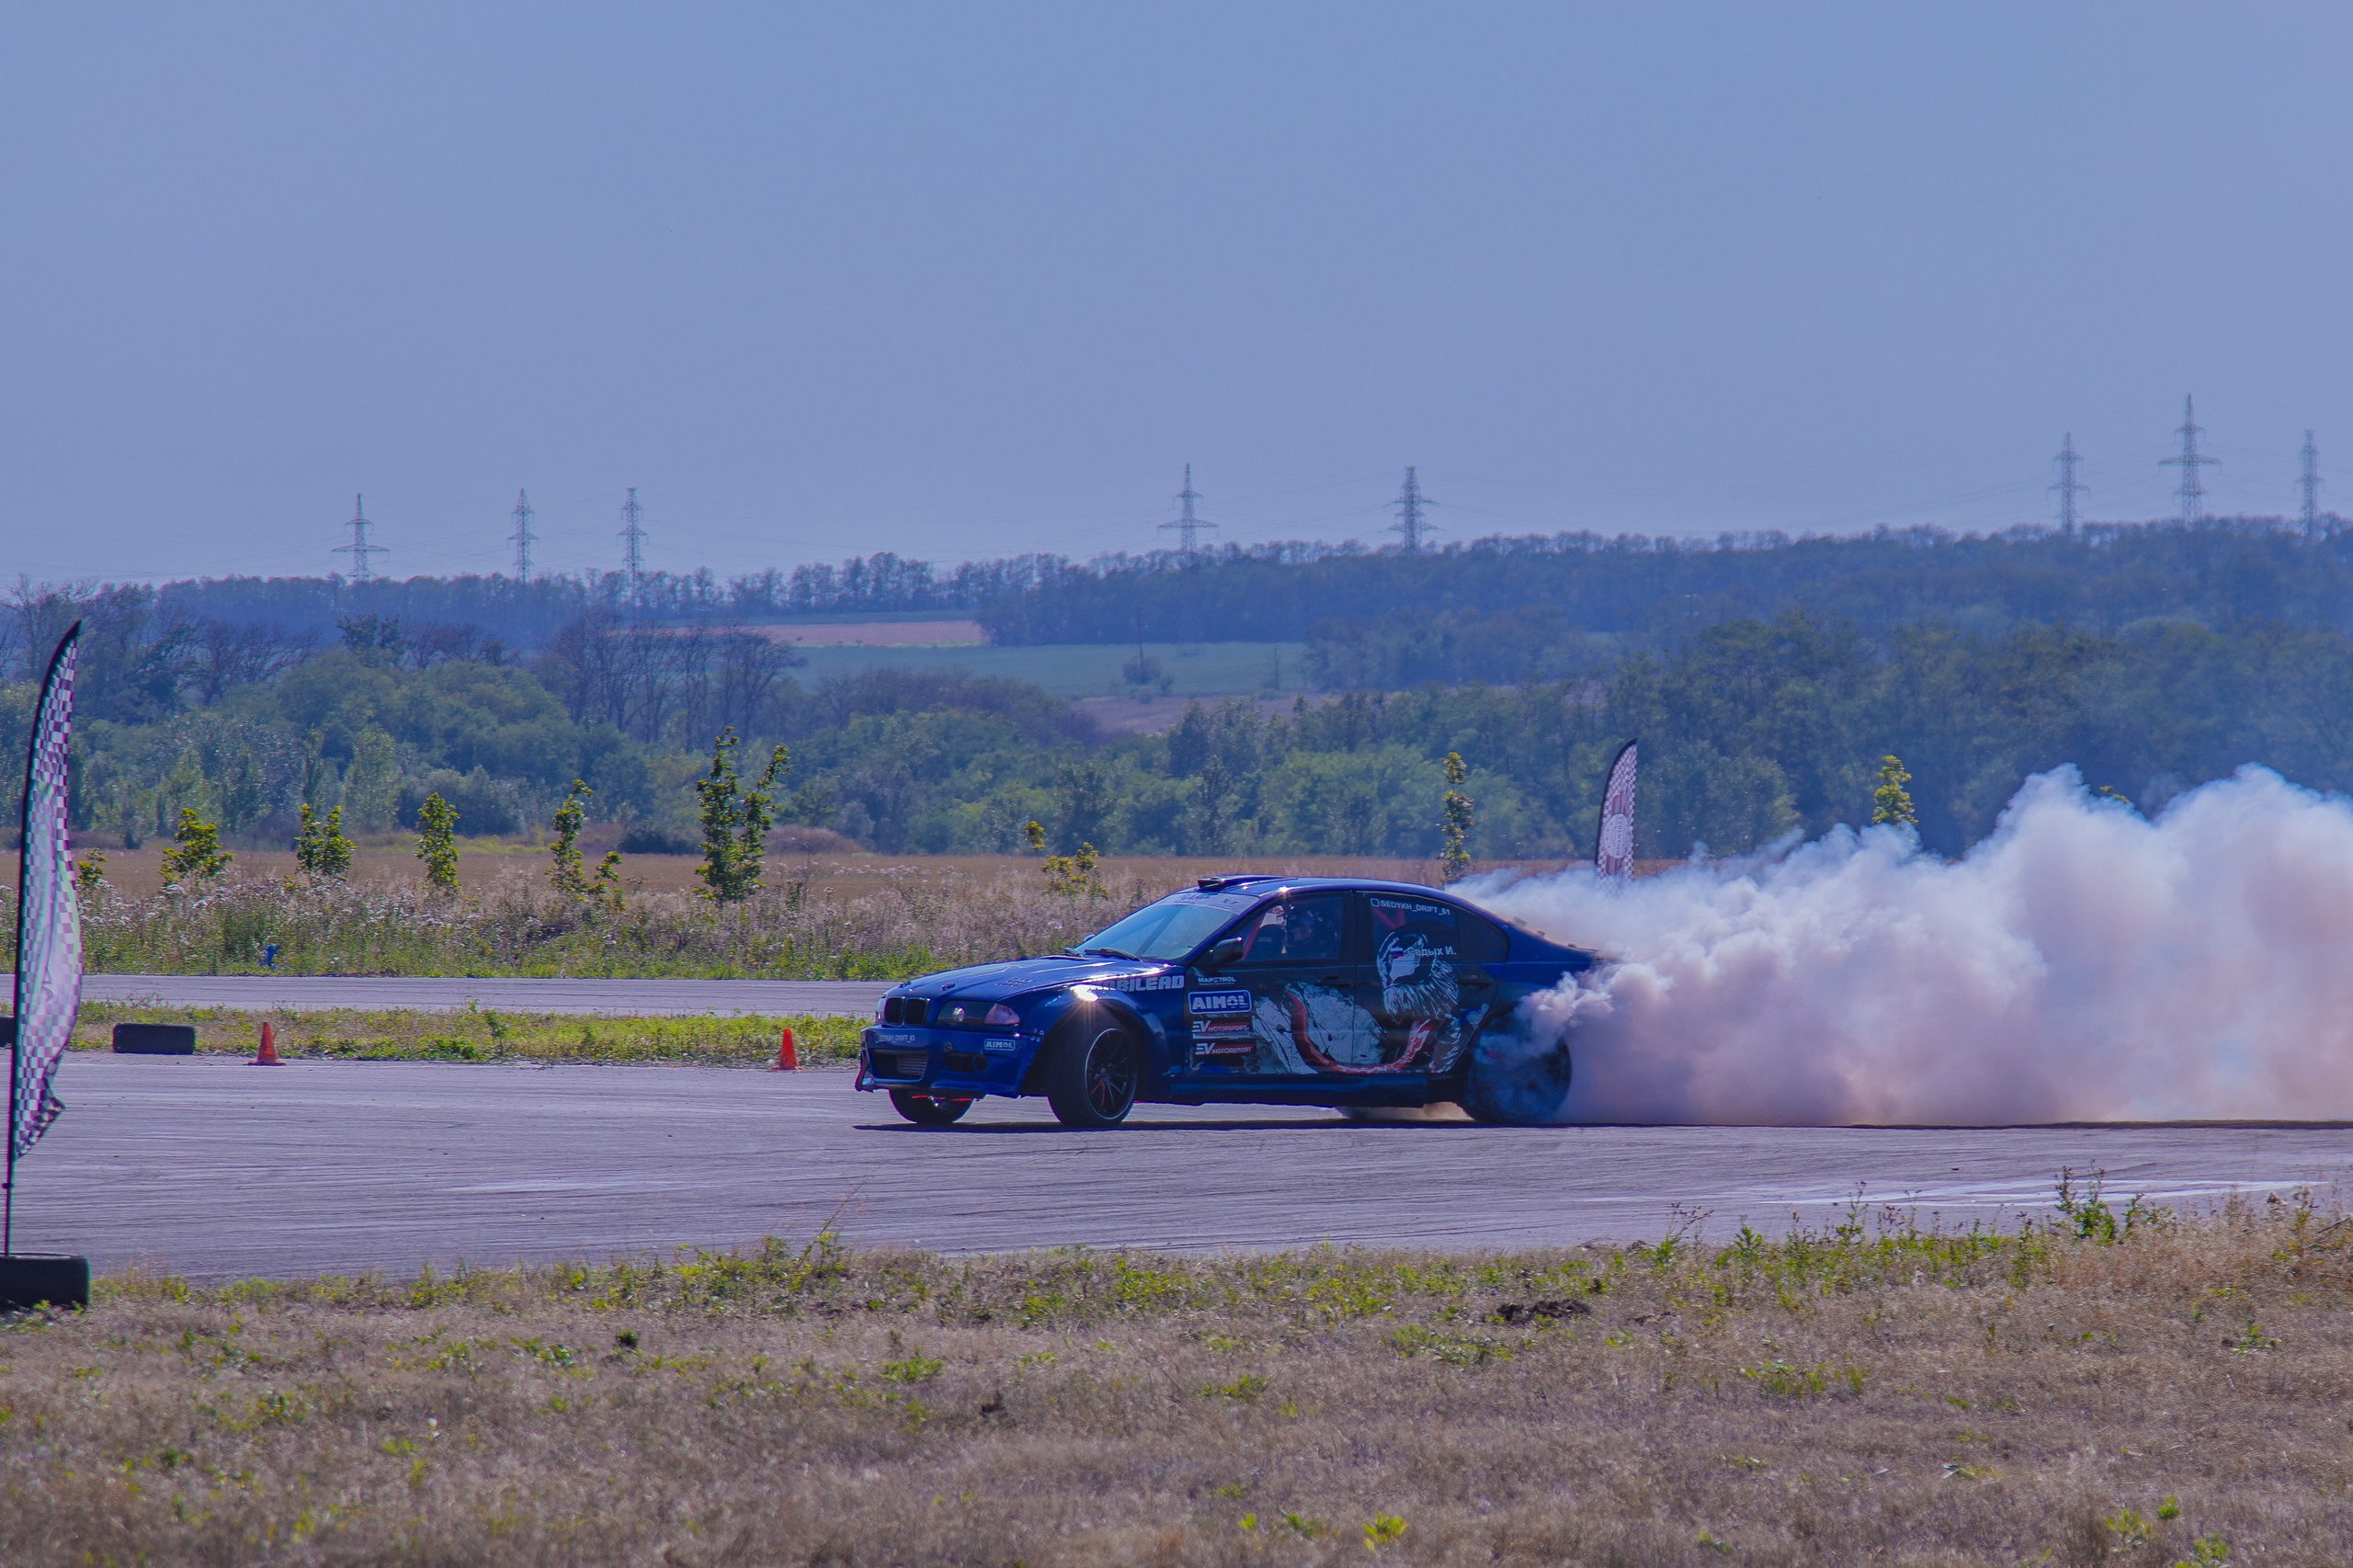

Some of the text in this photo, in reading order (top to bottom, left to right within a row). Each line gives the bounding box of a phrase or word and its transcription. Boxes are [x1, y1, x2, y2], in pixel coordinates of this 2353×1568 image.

[1381, 900, 1450, 915] SEDYKH_DRIFT_61
[1445, 945, 1457, 956] И.
[1192, 994, 1249, 1010] AIMOL
[1192, 1020, 1211, 1033] EV
[985, 1040, 1013, 1049] AIMOL
[1195, 1042, 1252, 1055] EV MOTORSPORT
